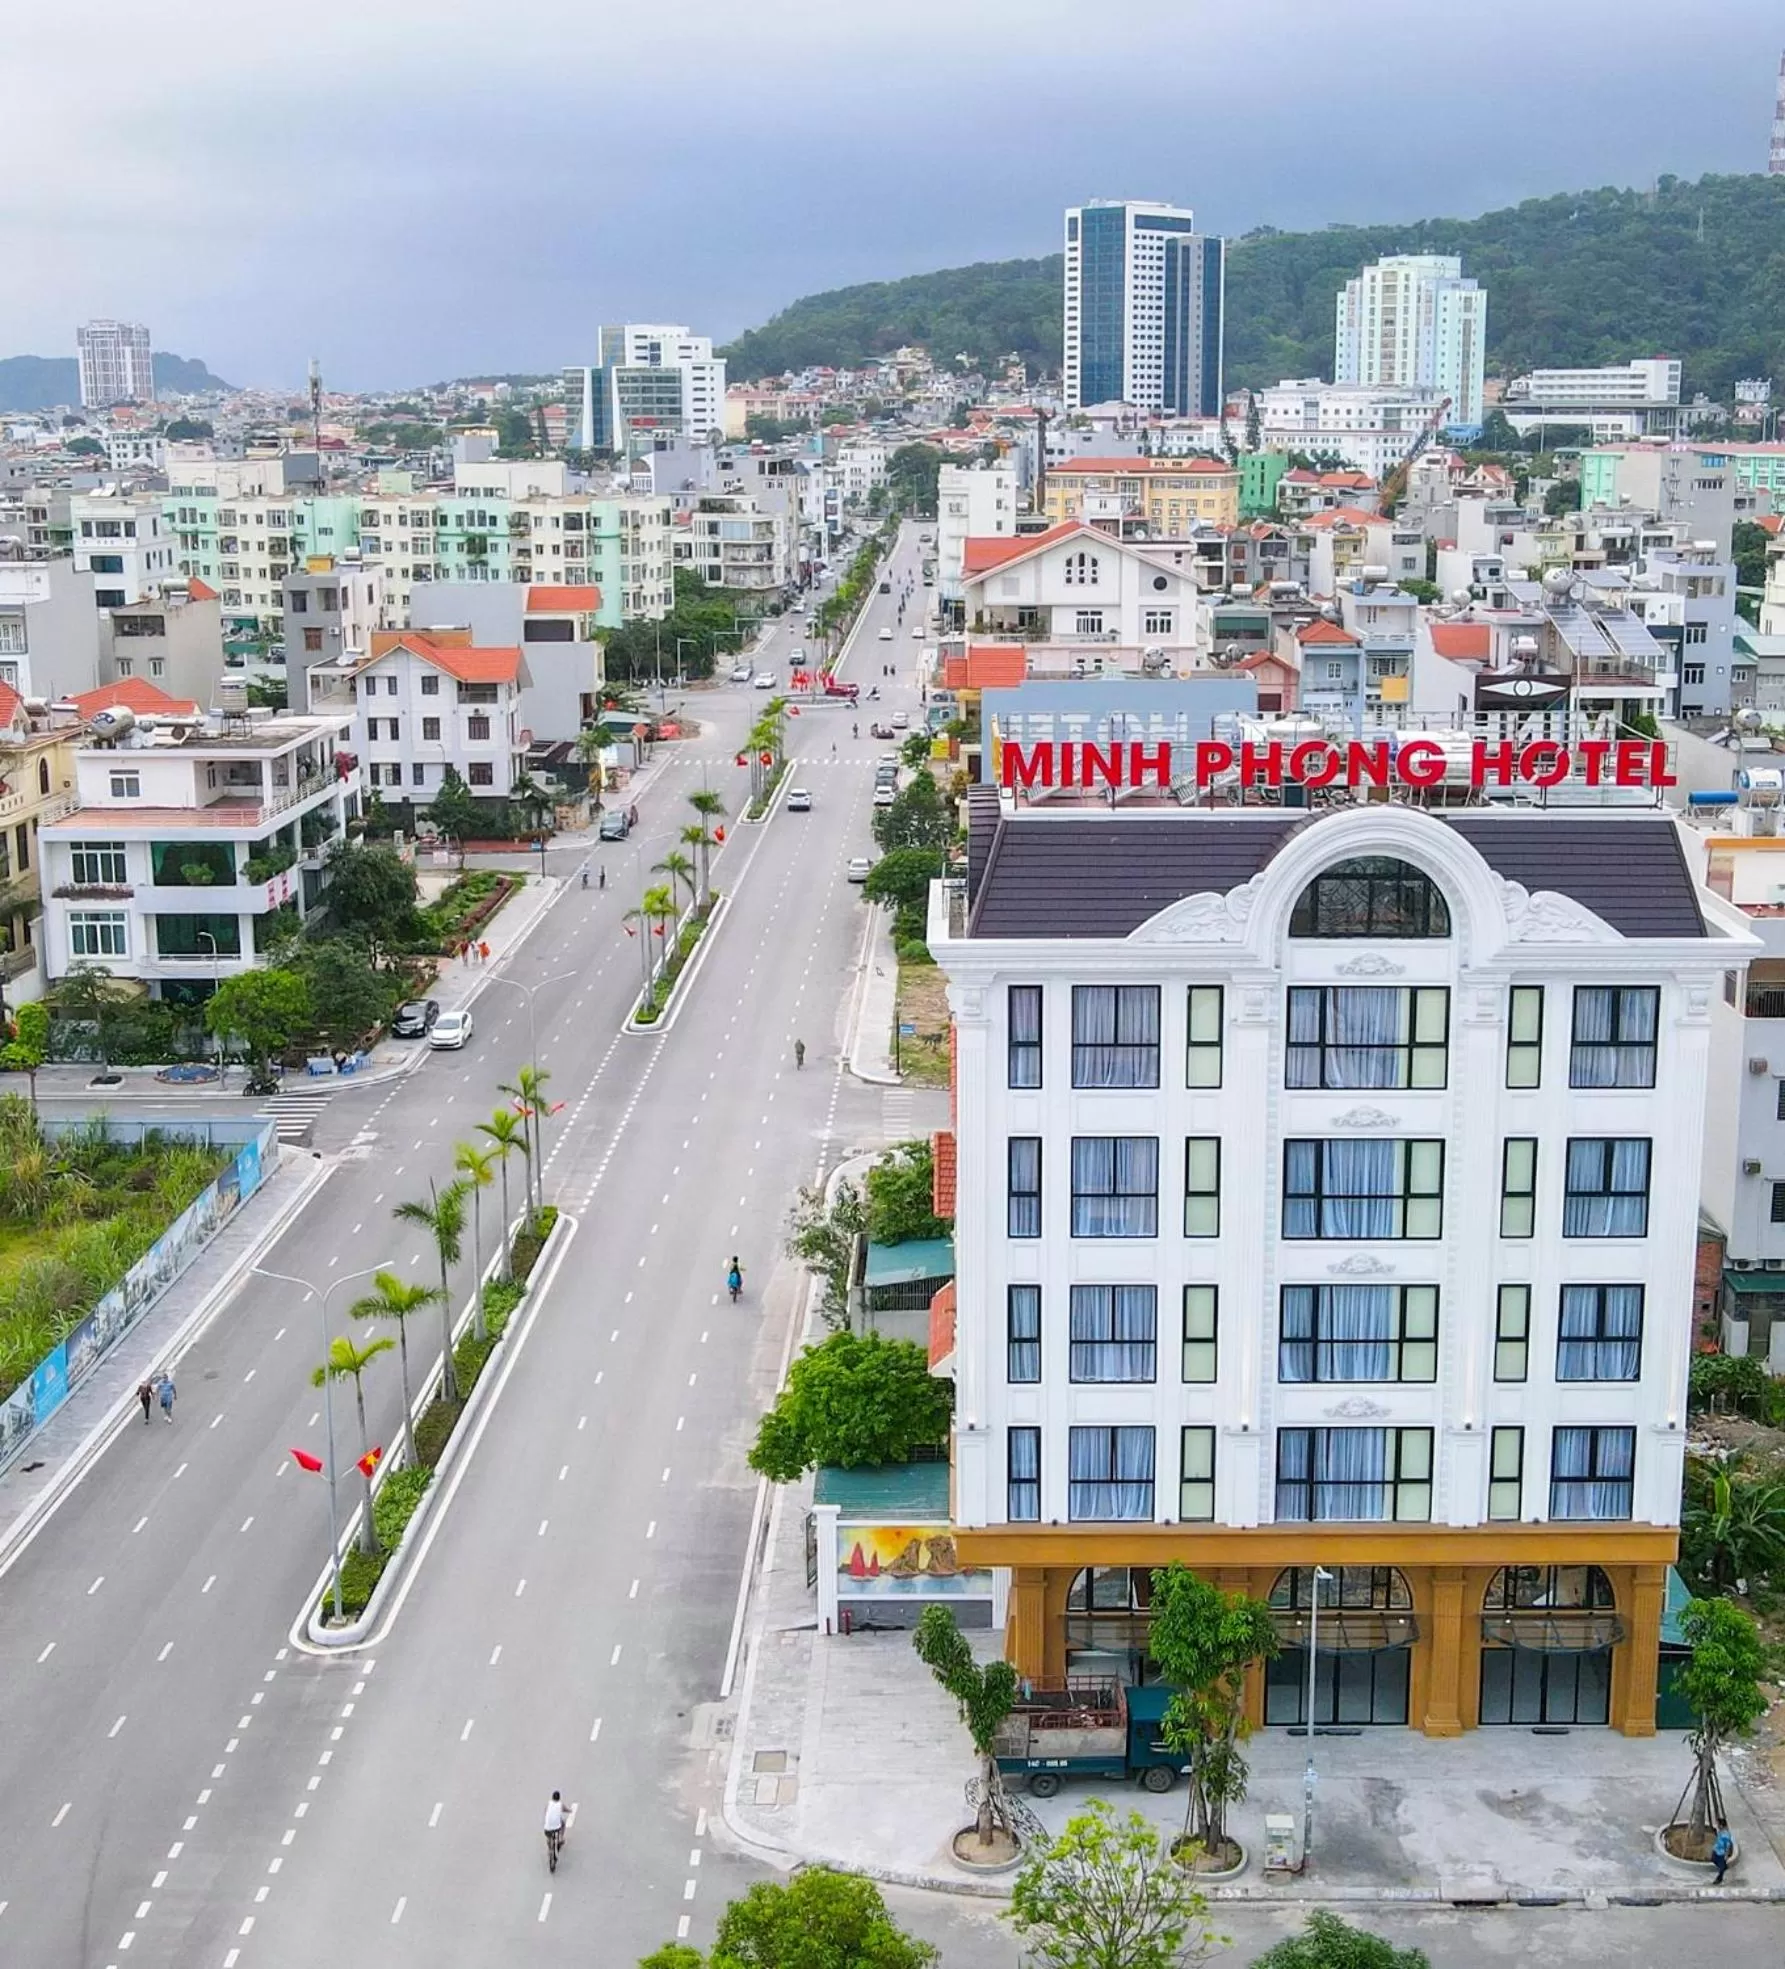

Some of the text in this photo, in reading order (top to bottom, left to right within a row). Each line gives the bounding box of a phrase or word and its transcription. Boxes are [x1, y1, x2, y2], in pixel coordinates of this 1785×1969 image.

[1002, 740, 1677, 788] MINH PHONG HOTEL
